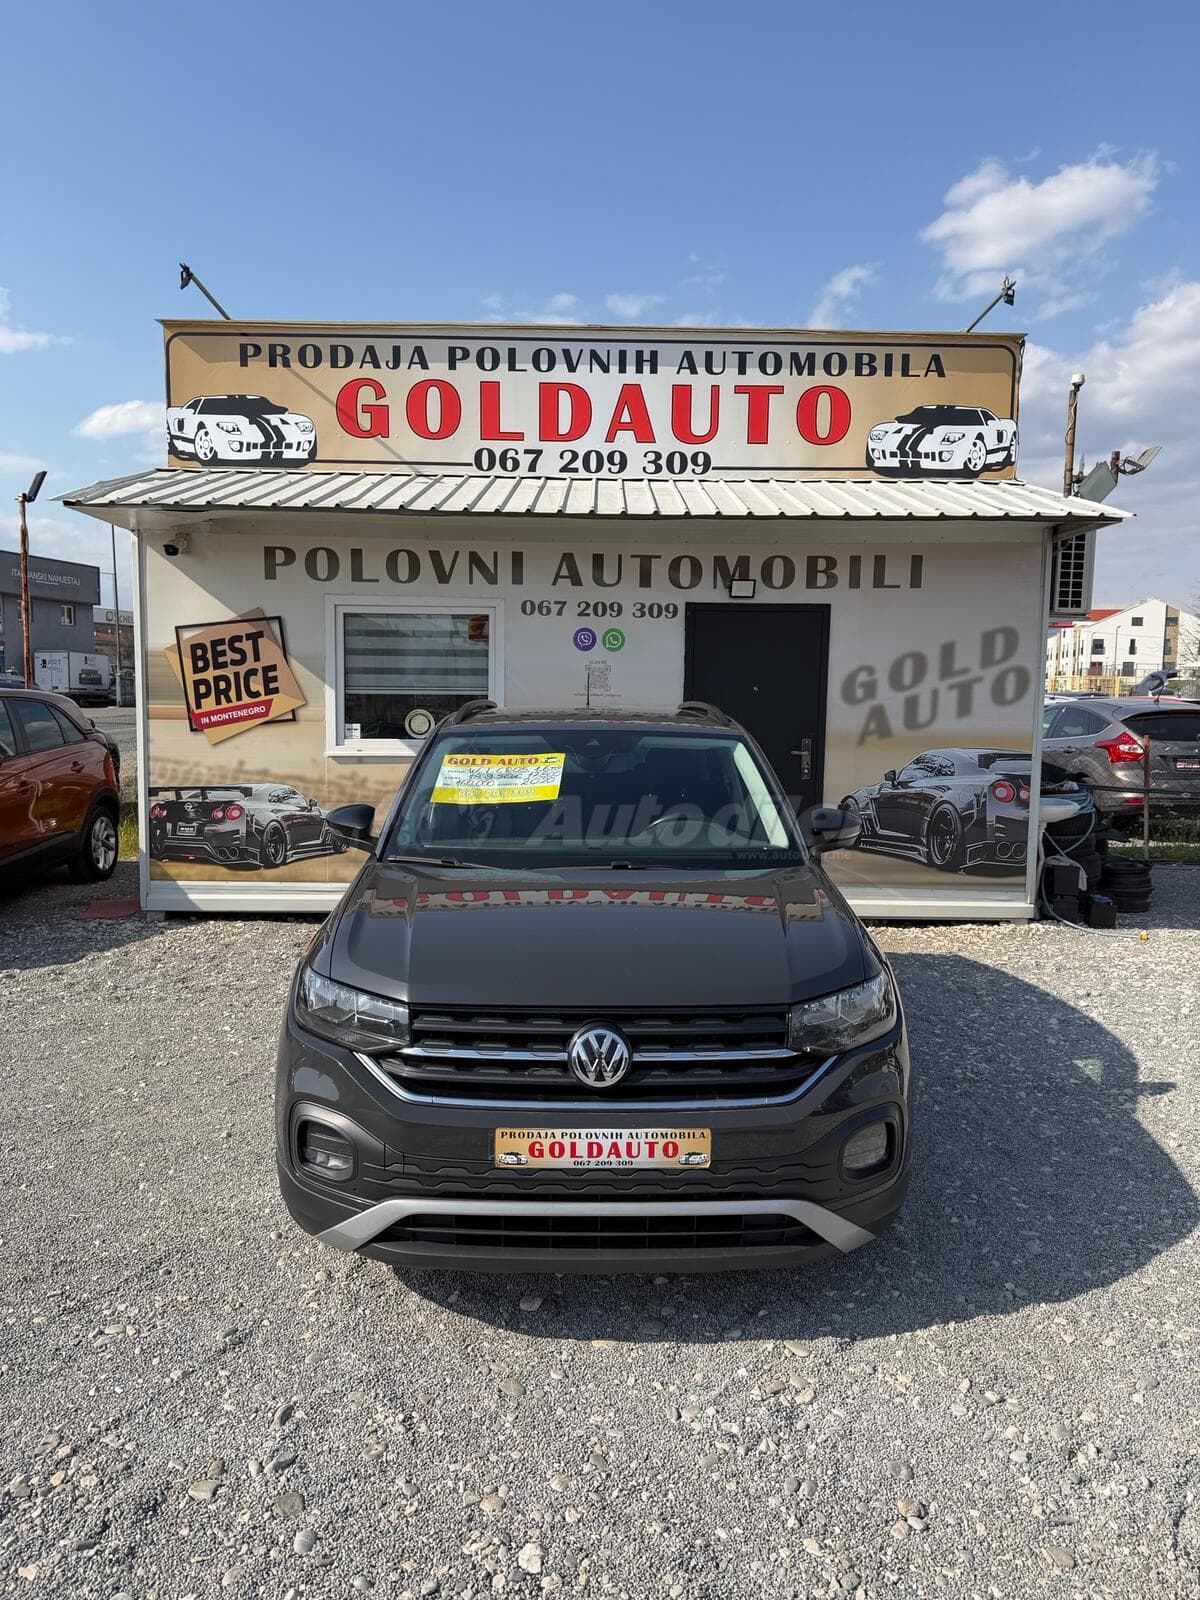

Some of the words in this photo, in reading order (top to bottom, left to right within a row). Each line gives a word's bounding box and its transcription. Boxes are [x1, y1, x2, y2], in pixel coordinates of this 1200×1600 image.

[239, 342, 430, 370] PRODAJA
[447, 345, 658, 374] POLOVNIH
[676, 349, 947, 378] AUTOMOBILA
[335, 377, 852, 446] GOLDAUTO
[473, 447, 544, 473] 067
[559, 448, 628, 475] 209
[642, 450, 713, 476] 309
[263, 545, 524, 586] POLOVNI
[551, 550, 924, 591] AUTOMOBILI
[521, 599, 567, 617] 067
[577, 601, 623, 618] 209
[632, 602, 679, 619] 309
[190, 630, 264, 675] BEST
[840, 625, 1019, 706] GOLD
[192, 664, 280, 710] PRICE
[856, 664, 1031, 746] AUTO
[201, 715, 210, 725] IN
[210, 705, 266, 723] MONTENEGRO
[447, 757, 492, 765] GOLD
[496, 757, 539, 765] AUTO
[501, 1131, 556, 1139] PRODAJA
[561, 1131, 623, 1140] POLOVNIH
[627, 1131, 706, 1140] AUTOMOBILA
[528, 1141, 679, 1159] GOLDAUTO
